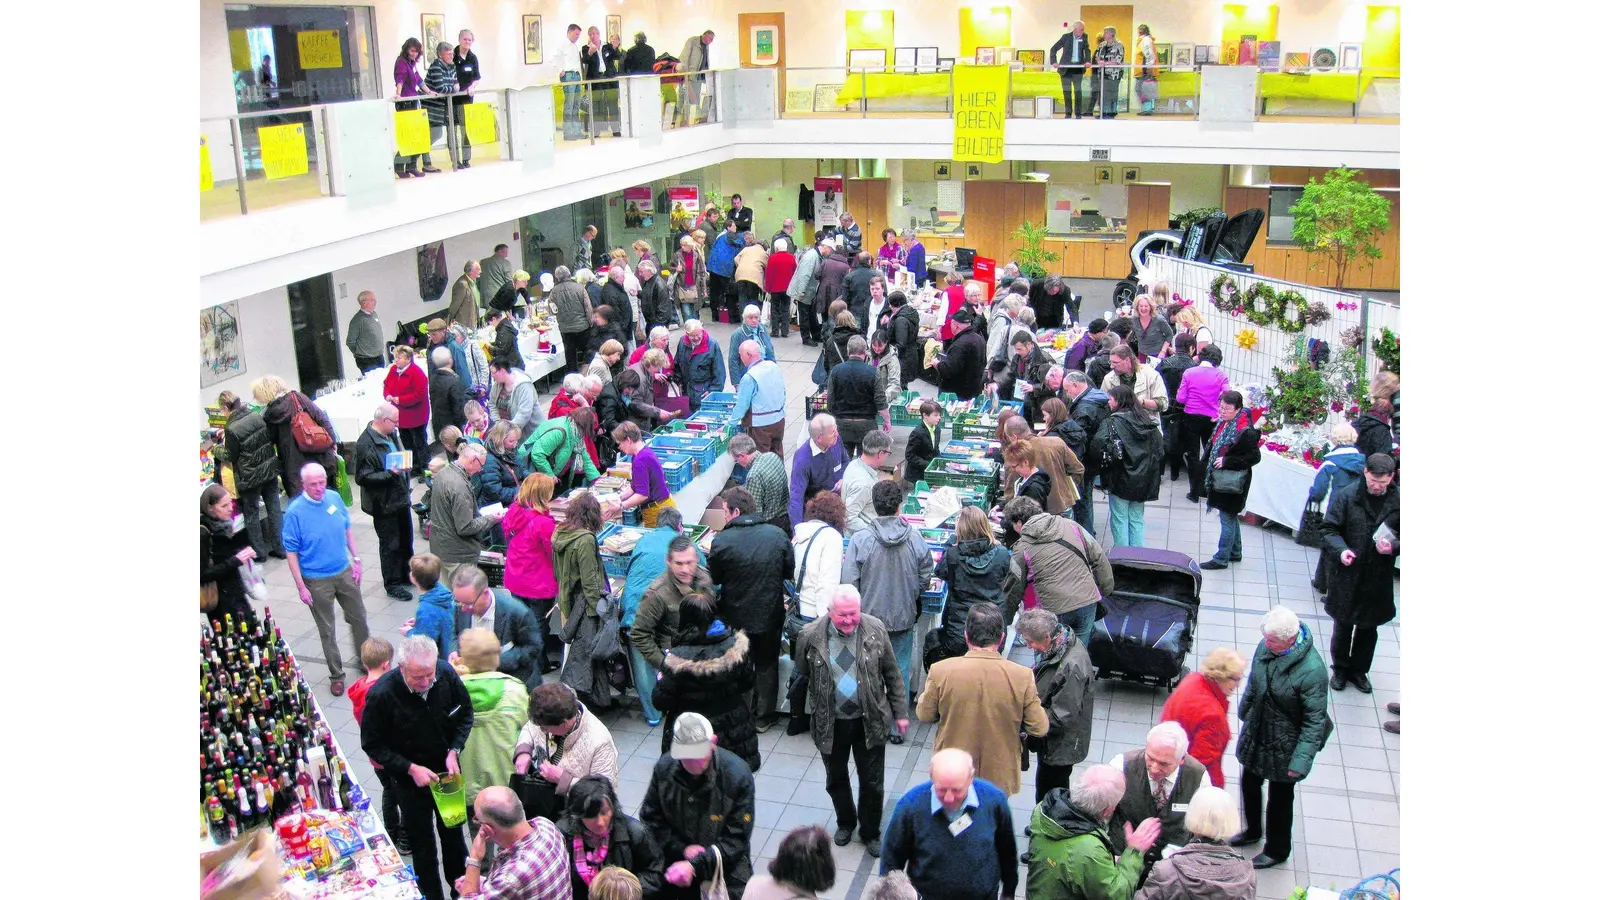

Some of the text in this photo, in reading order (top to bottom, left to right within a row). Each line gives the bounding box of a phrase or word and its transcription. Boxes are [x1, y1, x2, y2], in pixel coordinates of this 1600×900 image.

[960, 91, 997, 108] HIER
[956, 110, 1002, 130] OBEN
[956, 136, 1004, 157] BILDER
